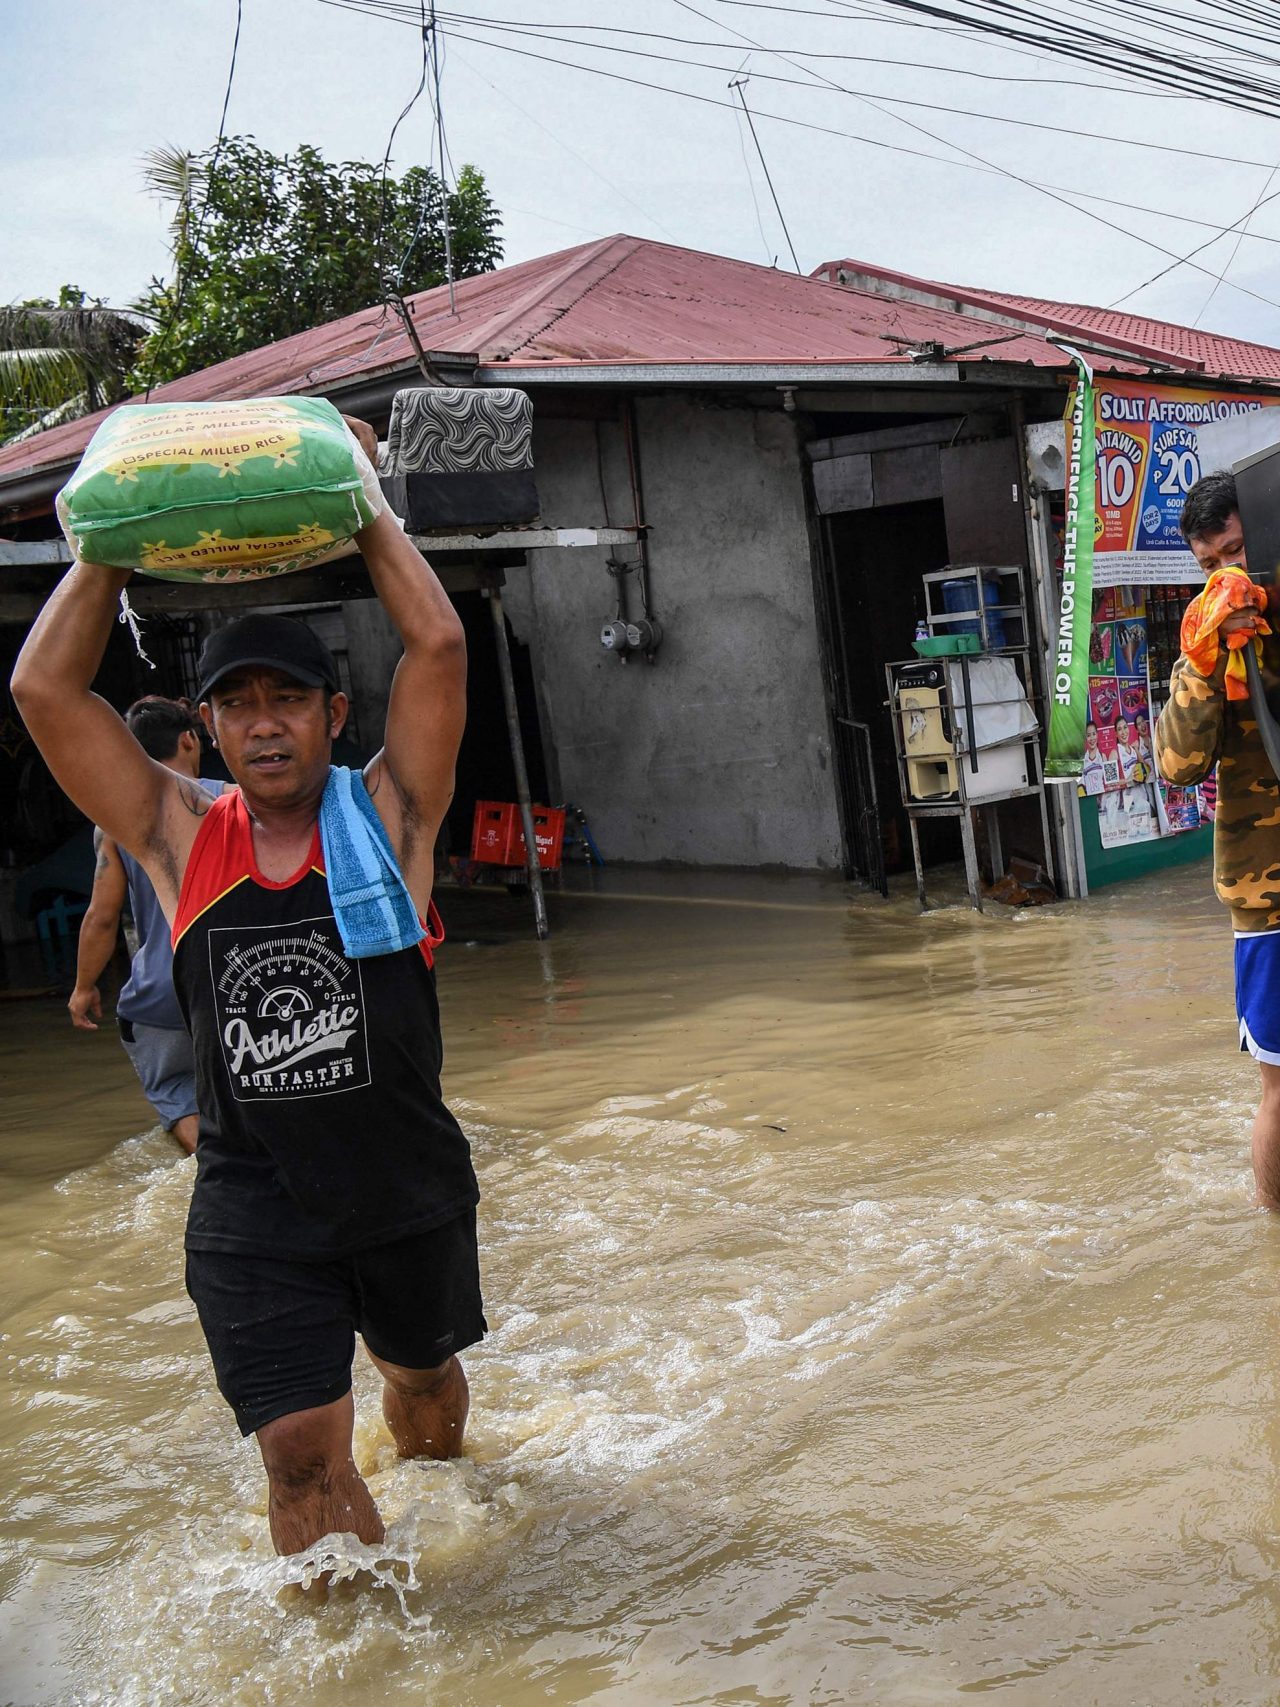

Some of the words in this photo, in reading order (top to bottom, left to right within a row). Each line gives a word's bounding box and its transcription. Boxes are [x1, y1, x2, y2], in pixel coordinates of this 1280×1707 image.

[1100, 393, 1145, 423] SULIT
[202, 418, 261, 430] MILLED
[137, 448, 195, 462] SPECIAL
[200, 443, 251, 456] MILLED
[255, 434, 286, 449] RICE
[1095, 431, 1142, 464] ANTAWID
[1099, 455, 1135, 507] 10
[1145, 519, 1159, 528] DAYS
[190, 544, 240, 557] MILLED
[248, 538, 302, 550] SPECIAL
[1063, 527, 1078, 574] THE
[1057, 581, 1075, 667] POWER
[1055, 673, 1072, 706] OF
[267, 968, 276, 977] 80
[283, 965, 292, 973] 60
[313, 979, 323, 987] 20
[324, 992, 330, 1000] 0
[225, 1006, 247, 1014] TRACK
[332, 993, 356, 1003] FIELD
[224, 1003, 359, 1075] Athletic
[240, 1073, 273, 1088] RUN
[279, 1063, 355, 1086] FASTER
